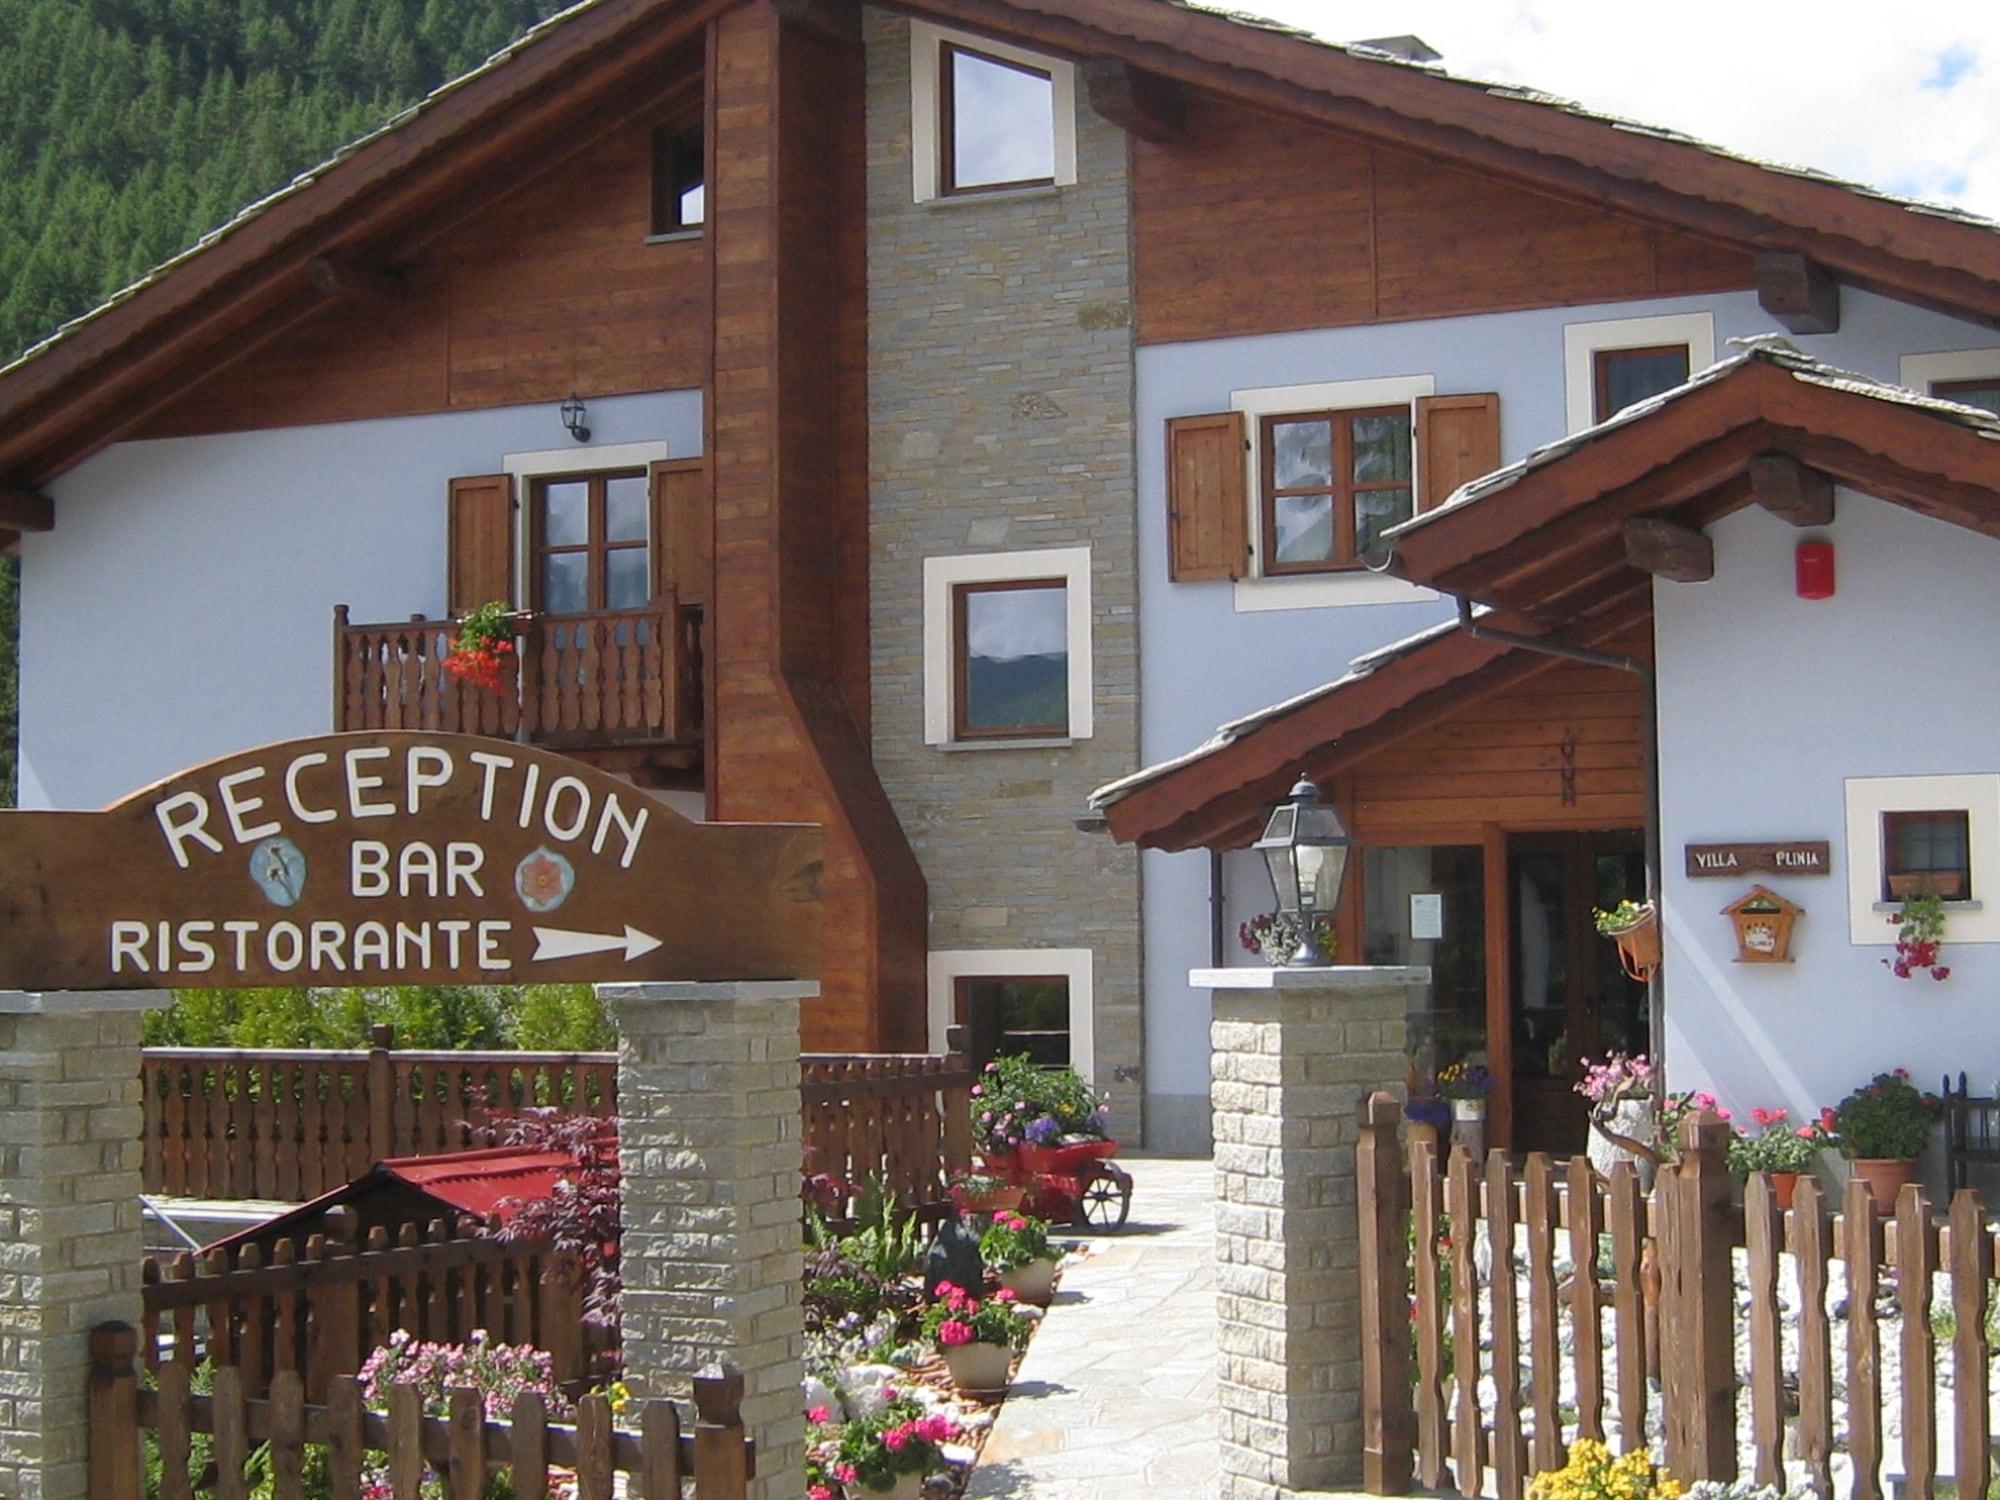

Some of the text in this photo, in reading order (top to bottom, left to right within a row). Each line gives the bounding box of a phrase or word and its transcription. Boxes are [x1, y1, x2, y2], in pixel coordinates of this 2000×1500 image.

[154, 745, 650, 869] RECEPTION
[350, 839, 485, 898] BAR
[1695, 851, 1819, 868] VILLA PLINIA
[110, 920, 513, 973] RISTORANTE
